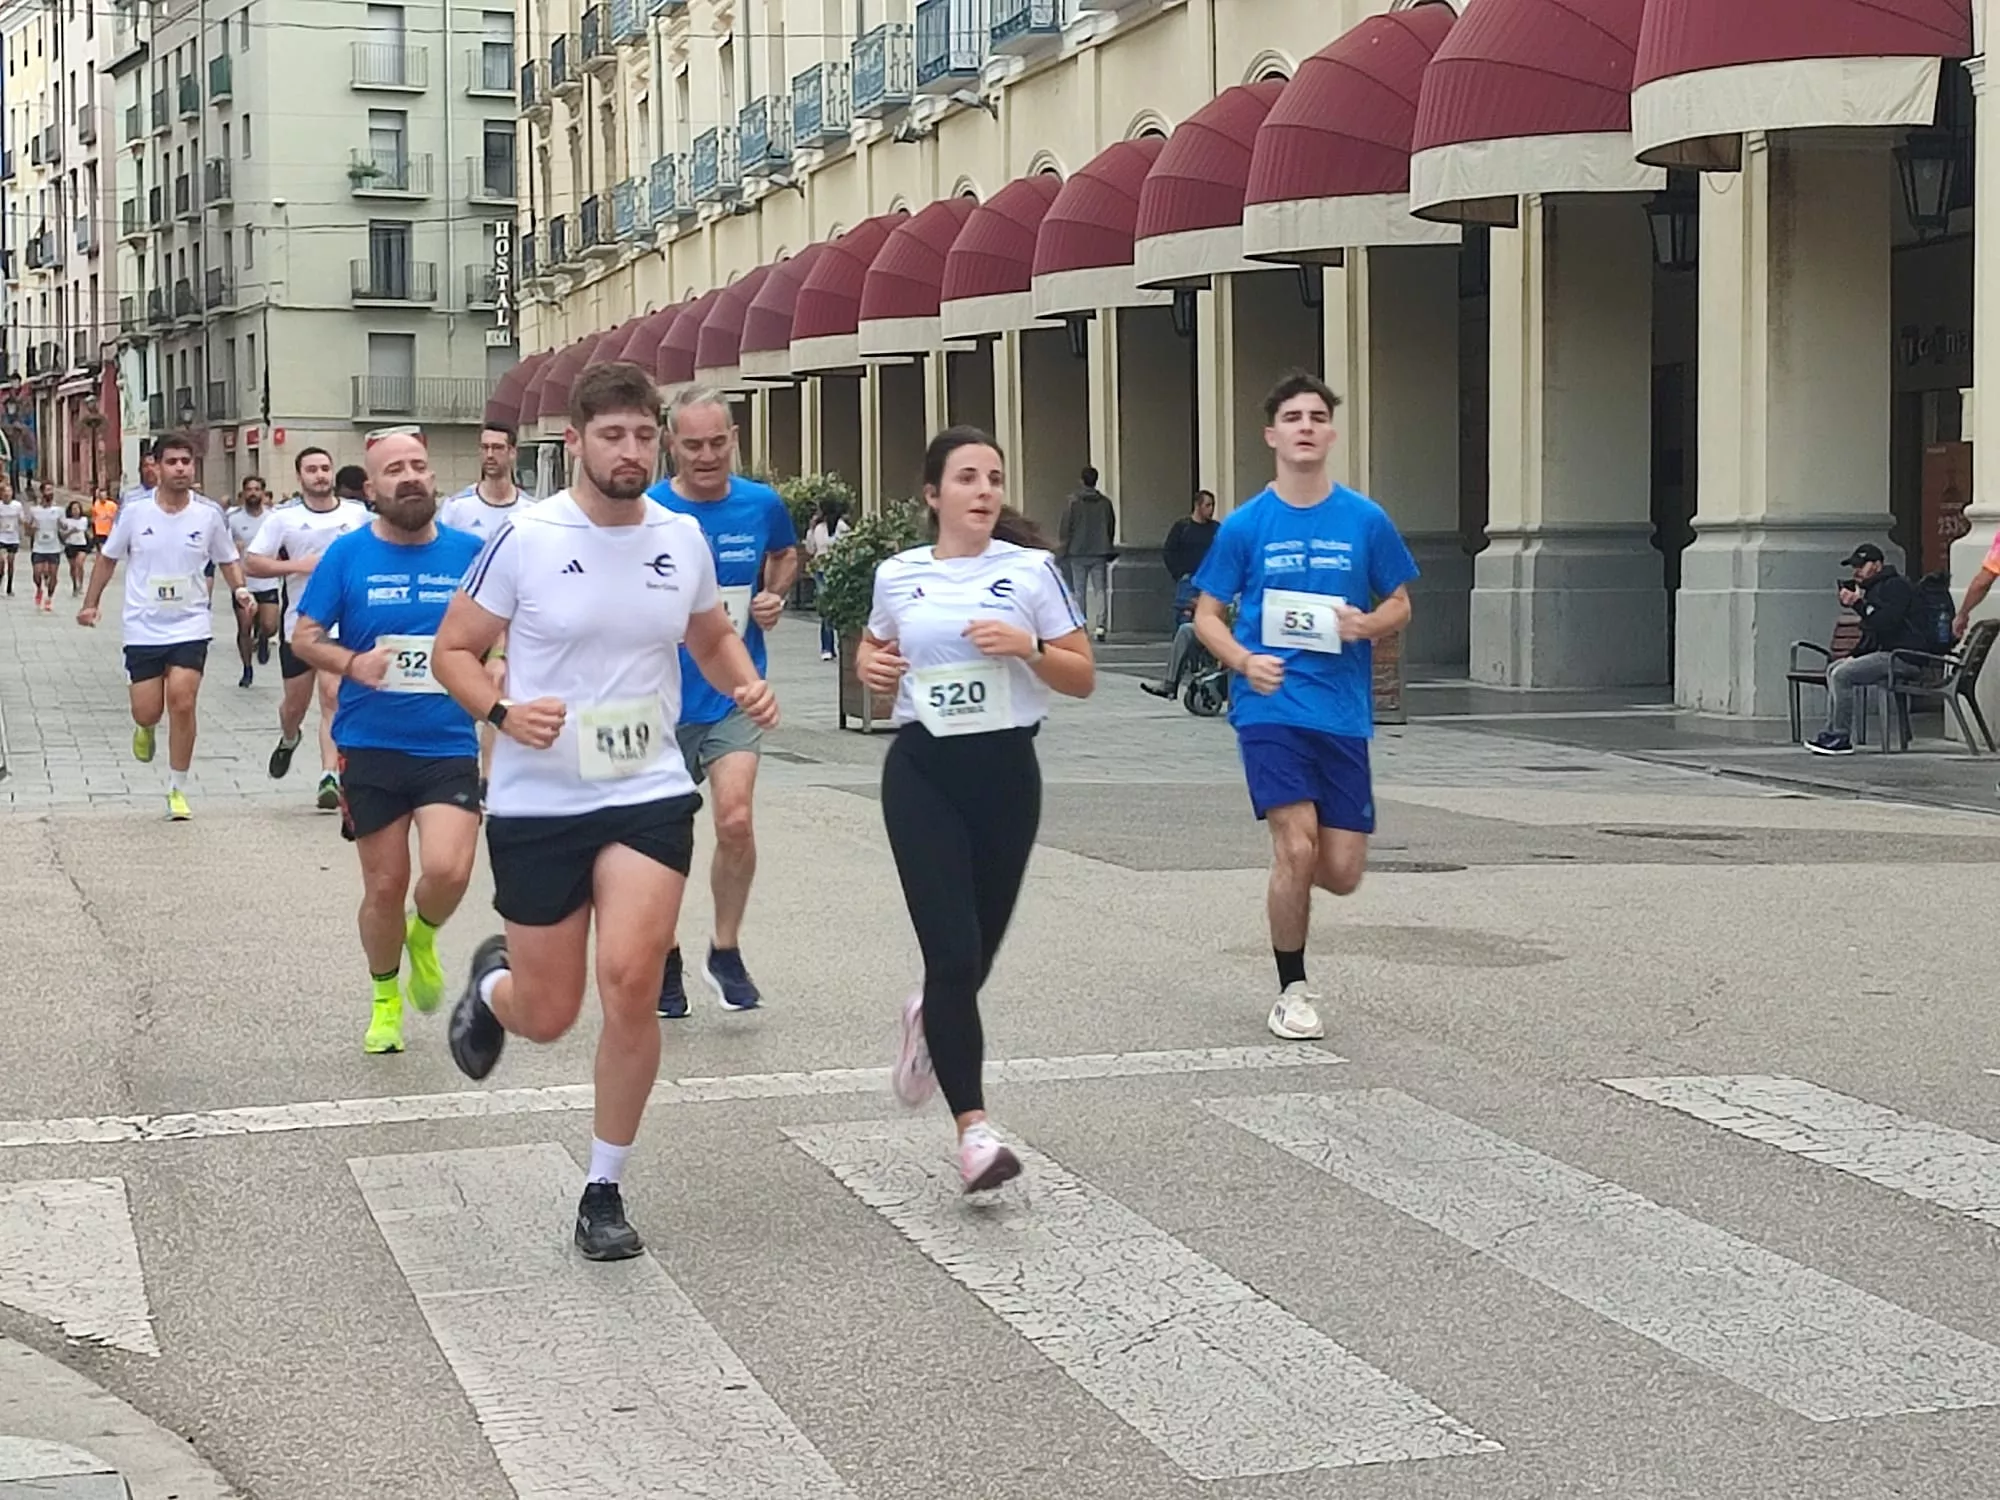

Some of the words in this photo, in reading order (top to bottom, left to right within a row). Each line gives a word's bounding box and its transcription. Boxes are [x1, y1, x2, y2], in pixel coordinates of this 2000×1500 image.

[495, 220, 510, 326] HOSTAL
[1284, 610, 1316, 631] 53
[929, 681, 986, 708] 520
